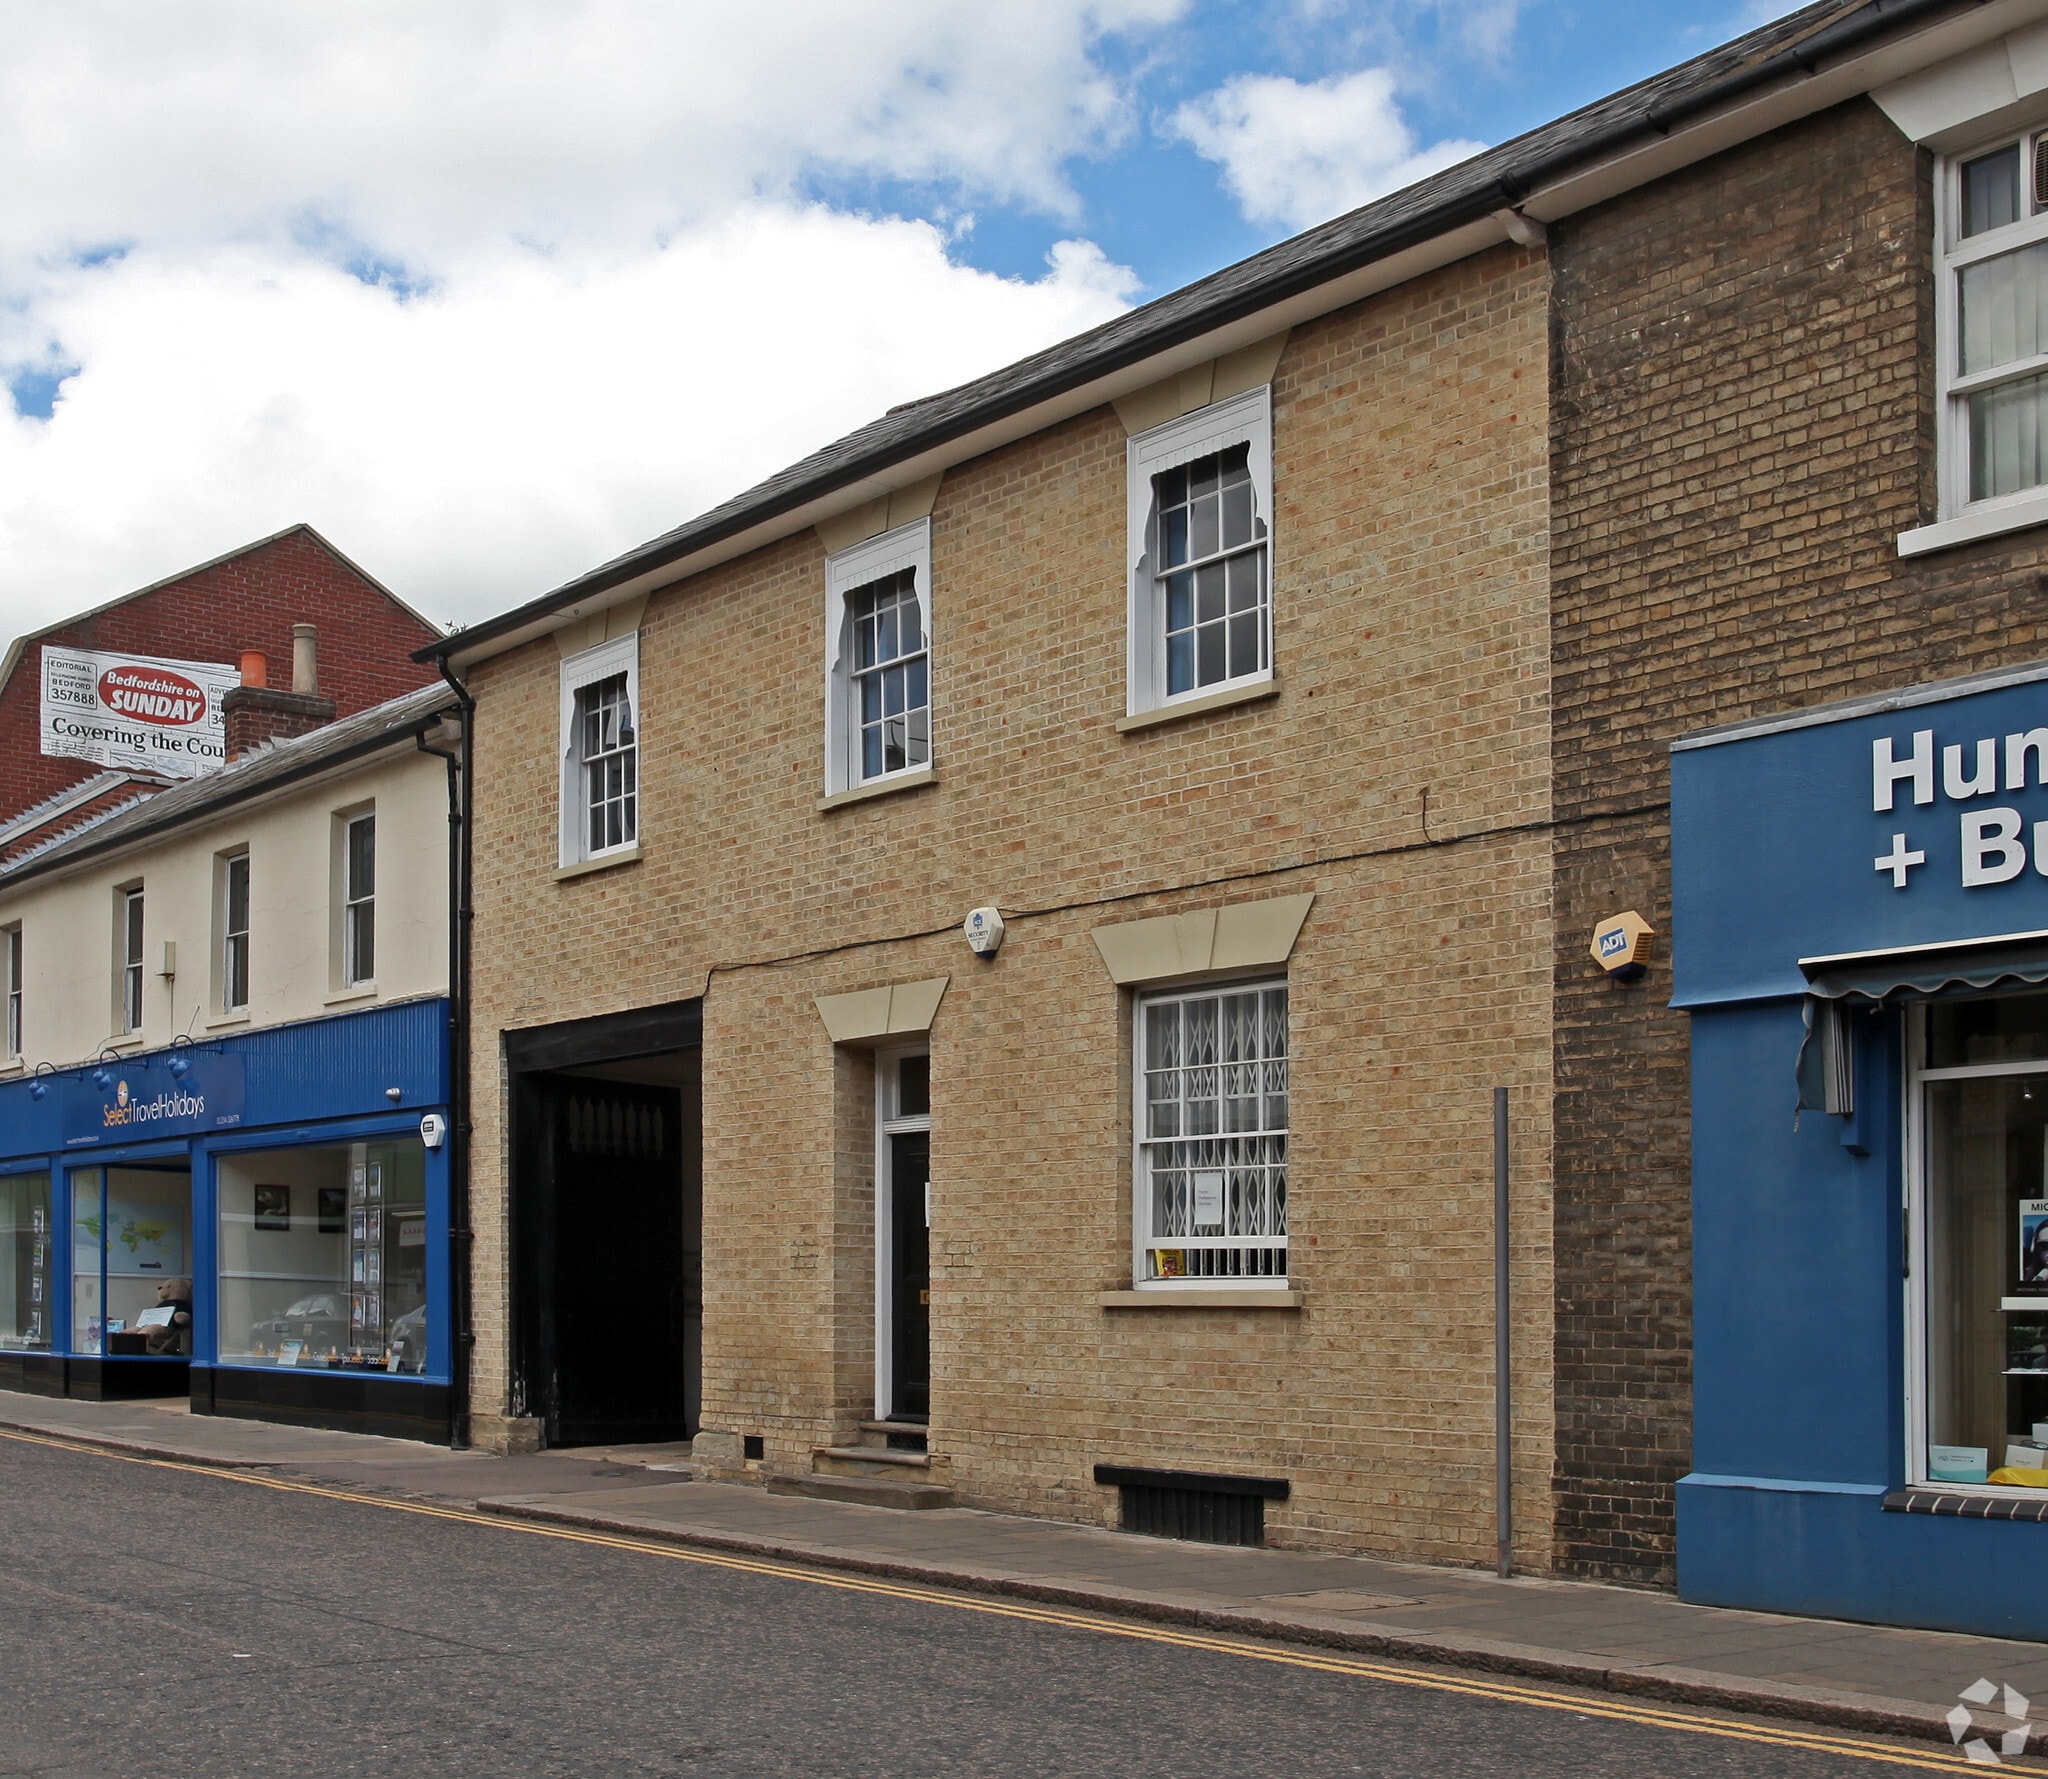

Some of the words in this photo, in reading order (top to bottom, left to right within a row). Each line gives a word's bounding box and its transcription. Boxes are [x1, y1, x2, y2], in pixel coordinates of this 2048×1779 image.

[51, 660, 92, 673] EDITORIAL
[52, 677, 91, 690] BEDFORD
[107, 671, 184, 695] Bedfordshire
[186, 688, 200, 698] on
[51, 688, 95, 705] 357888
[110, 690, 201, 721] SUNDAY
[52, 718, 146, 752] Covering
[151, 732, 182, 751] the
[1961, 807, 2048, 887] B
[1602, 932, 1625, 953] ADT
